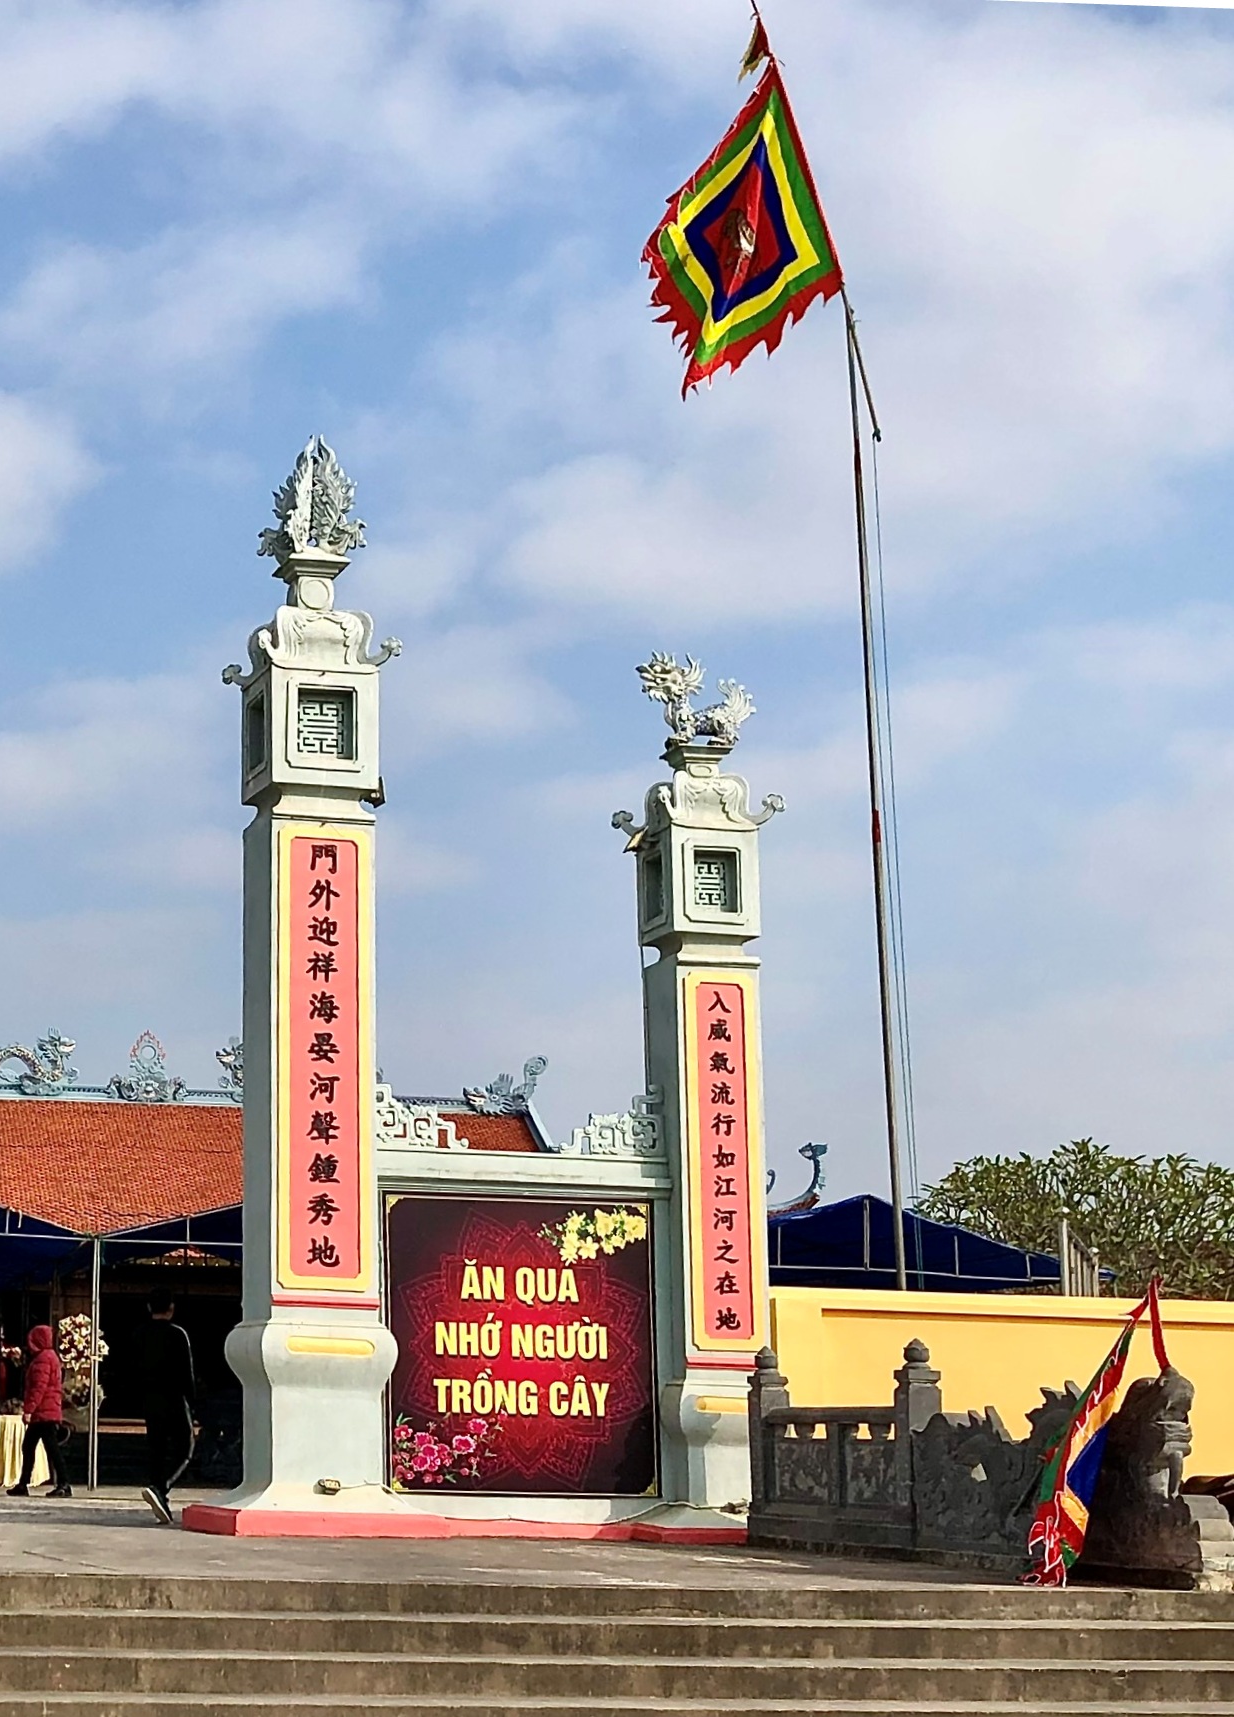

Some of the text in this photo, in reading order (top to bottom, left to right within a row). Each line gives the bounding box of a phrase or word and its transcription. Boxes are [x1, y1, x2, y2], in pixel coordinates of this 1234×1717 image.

[461, 1259, 504, 1299] ĂN
[436, 1313, 607, 1359] NHỚ NGƯỜI
[434, 1369, 609, 1416] TRỒNG CÂY
